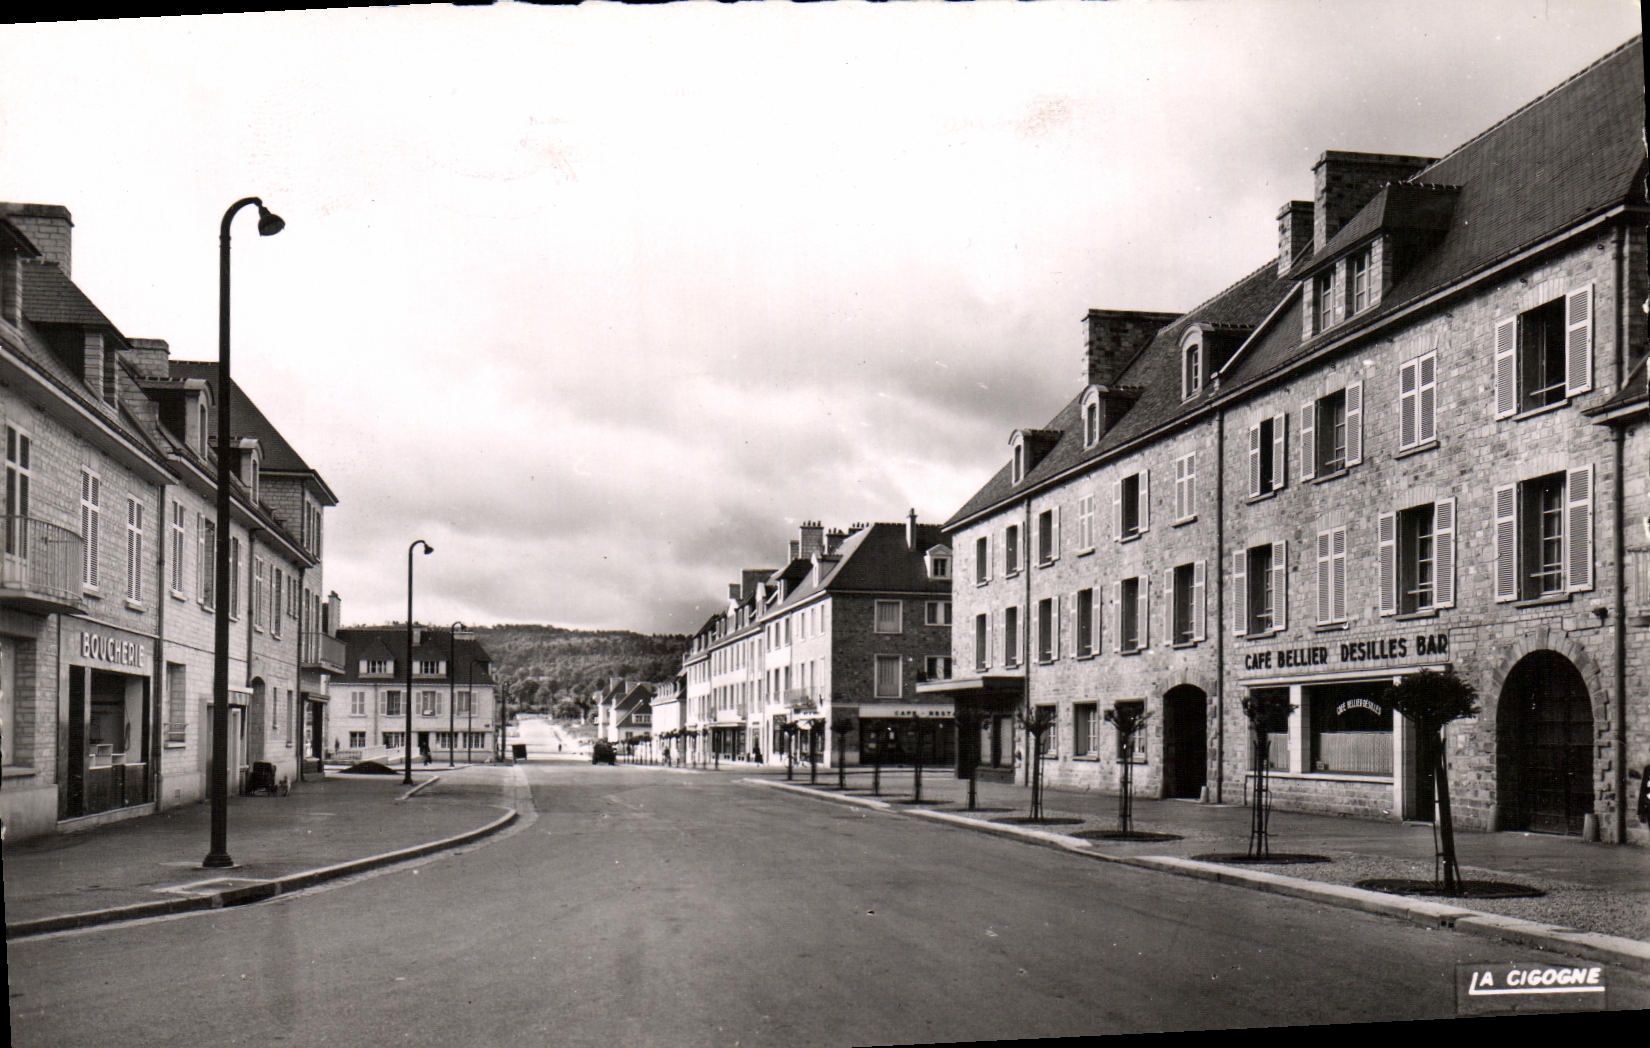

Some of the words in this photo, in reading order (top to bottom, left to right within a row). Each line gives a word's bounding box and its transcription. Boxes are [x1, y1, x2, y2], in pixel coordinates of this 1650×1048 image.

[81, 632, 144, 667] BOUCHERIE
[1278, 647, 1328, 668] BELLIER
[1341, 638, 1407, 662] DESILLES
[1417, 634, 1448, 656] BAR
